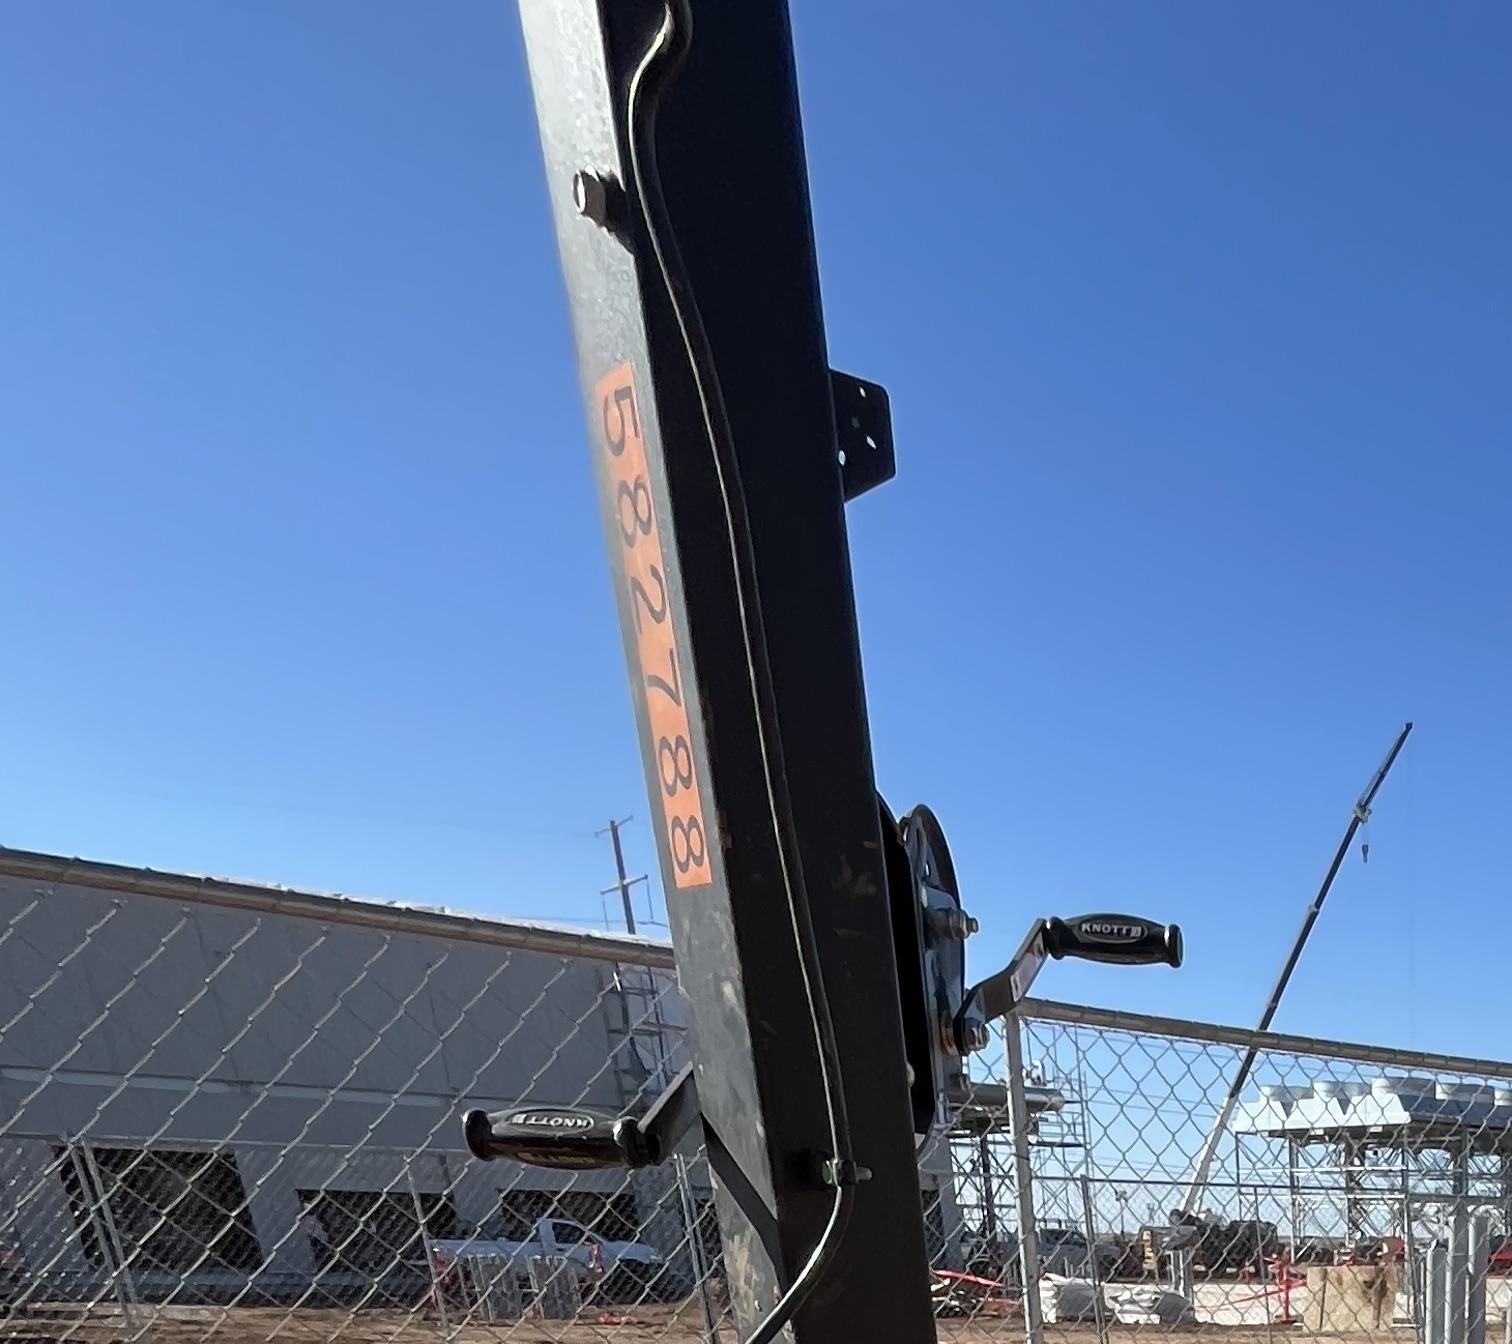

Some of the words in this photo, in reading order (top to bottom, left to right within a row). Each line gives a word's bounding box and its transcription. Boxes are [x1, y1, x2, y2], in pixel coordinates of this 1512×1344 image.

[603, 385, 705, 873] 582788
[1081, 922, 1129, 934] KNOTT
[525, 1115, 588, 1128] KNOTT
